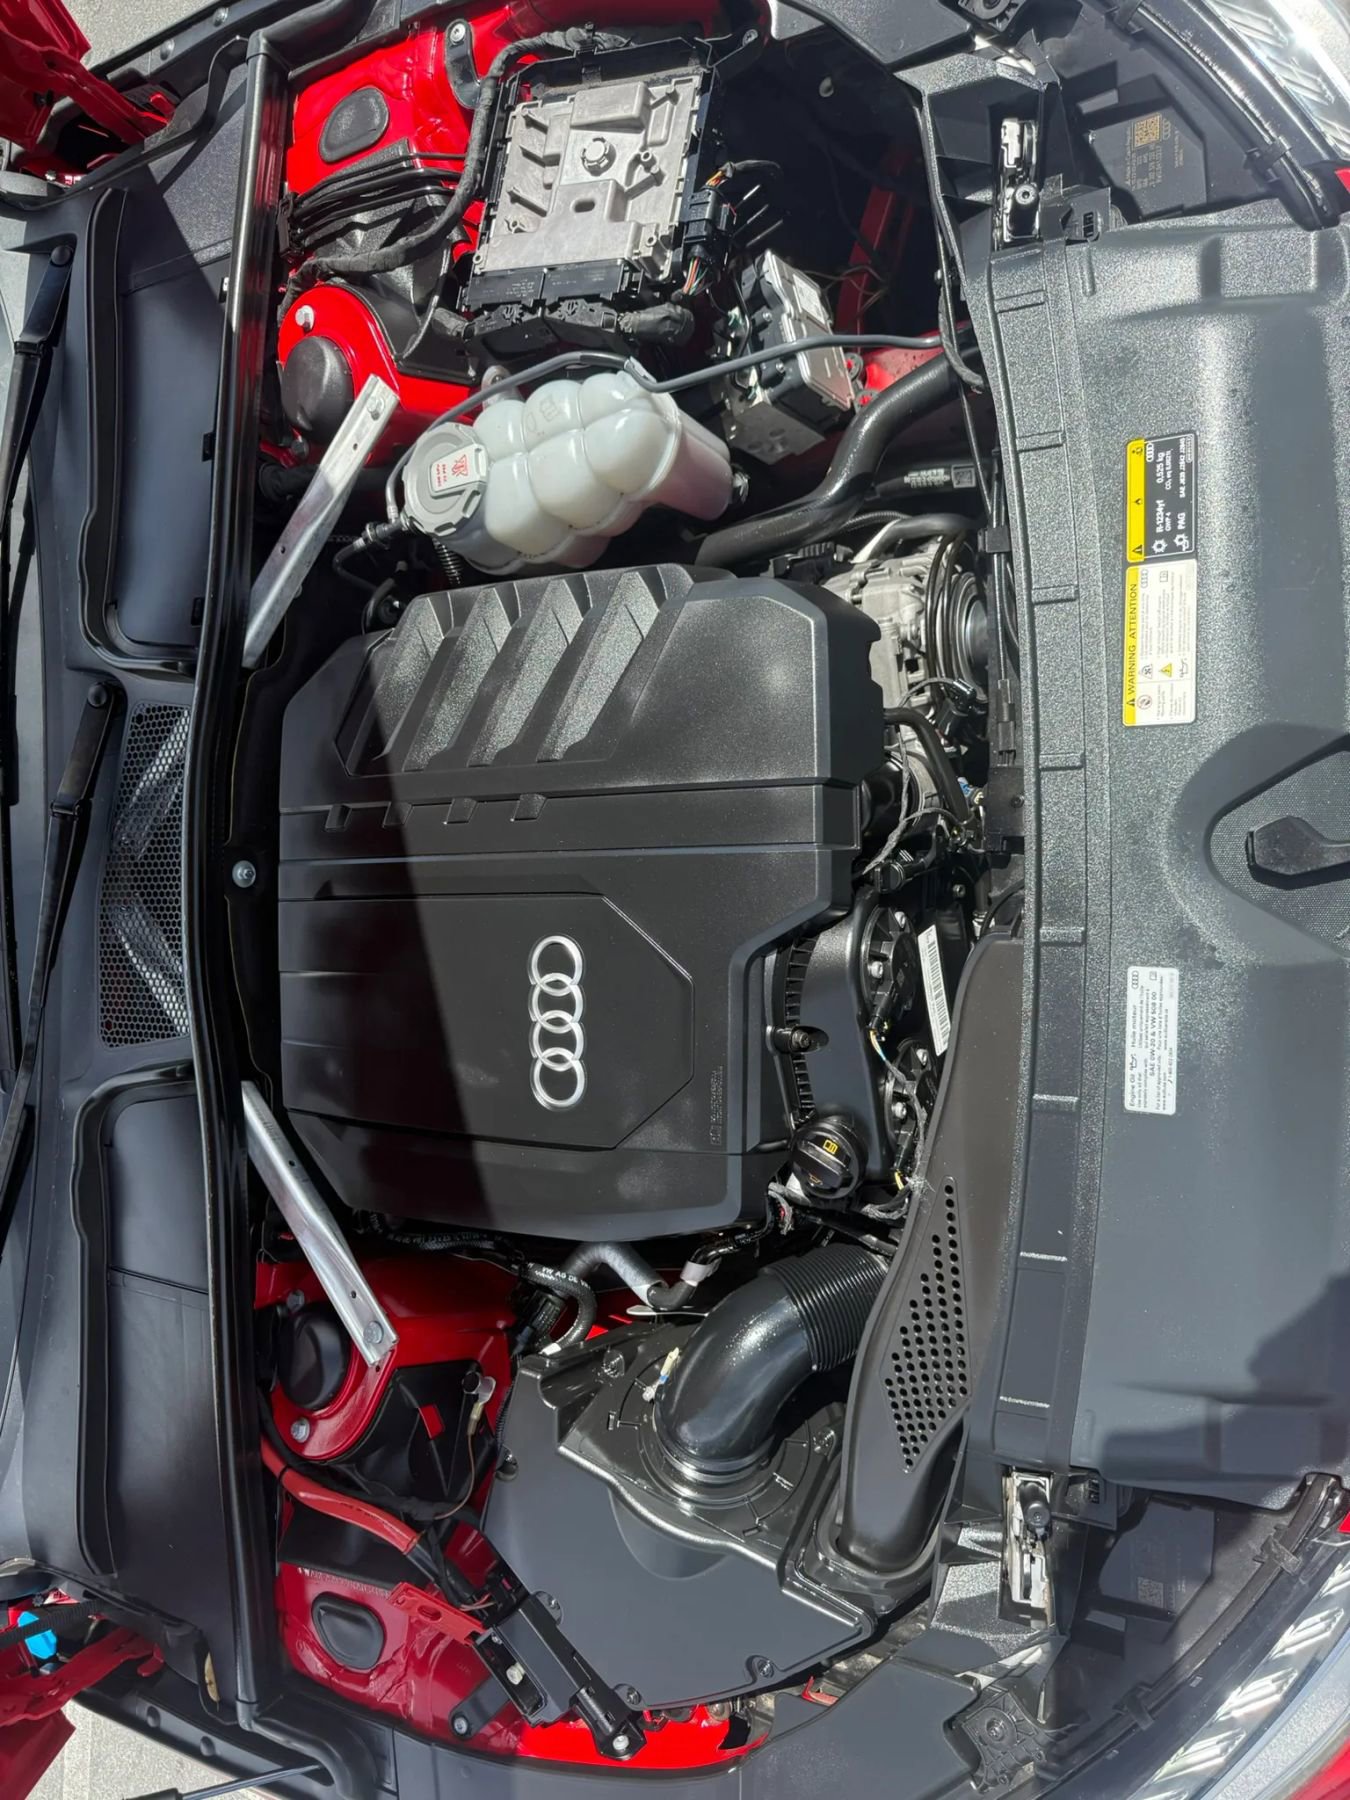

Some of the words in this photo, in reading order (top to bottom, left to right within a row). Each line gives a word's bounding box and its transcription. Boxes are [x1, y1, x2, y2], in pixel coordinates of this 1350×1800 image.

[1156, 452, 1166, 462] kg
[1155, 463, 1164, 484] 0,525
[1155, 499, 1165, 533] R-1234yf
[1177, 512, 1186, 530] PAG
[1129, 583, 1137, 640] ATTENTION
[1127, 645, 1136, 695] WARNING
[1151, 991, 1157, 1001] 00
[1150, 1016, 1156, 1029] VW
[542, 1266, 554, 1274] VW
[555, 1271, 567, 1279] AG
